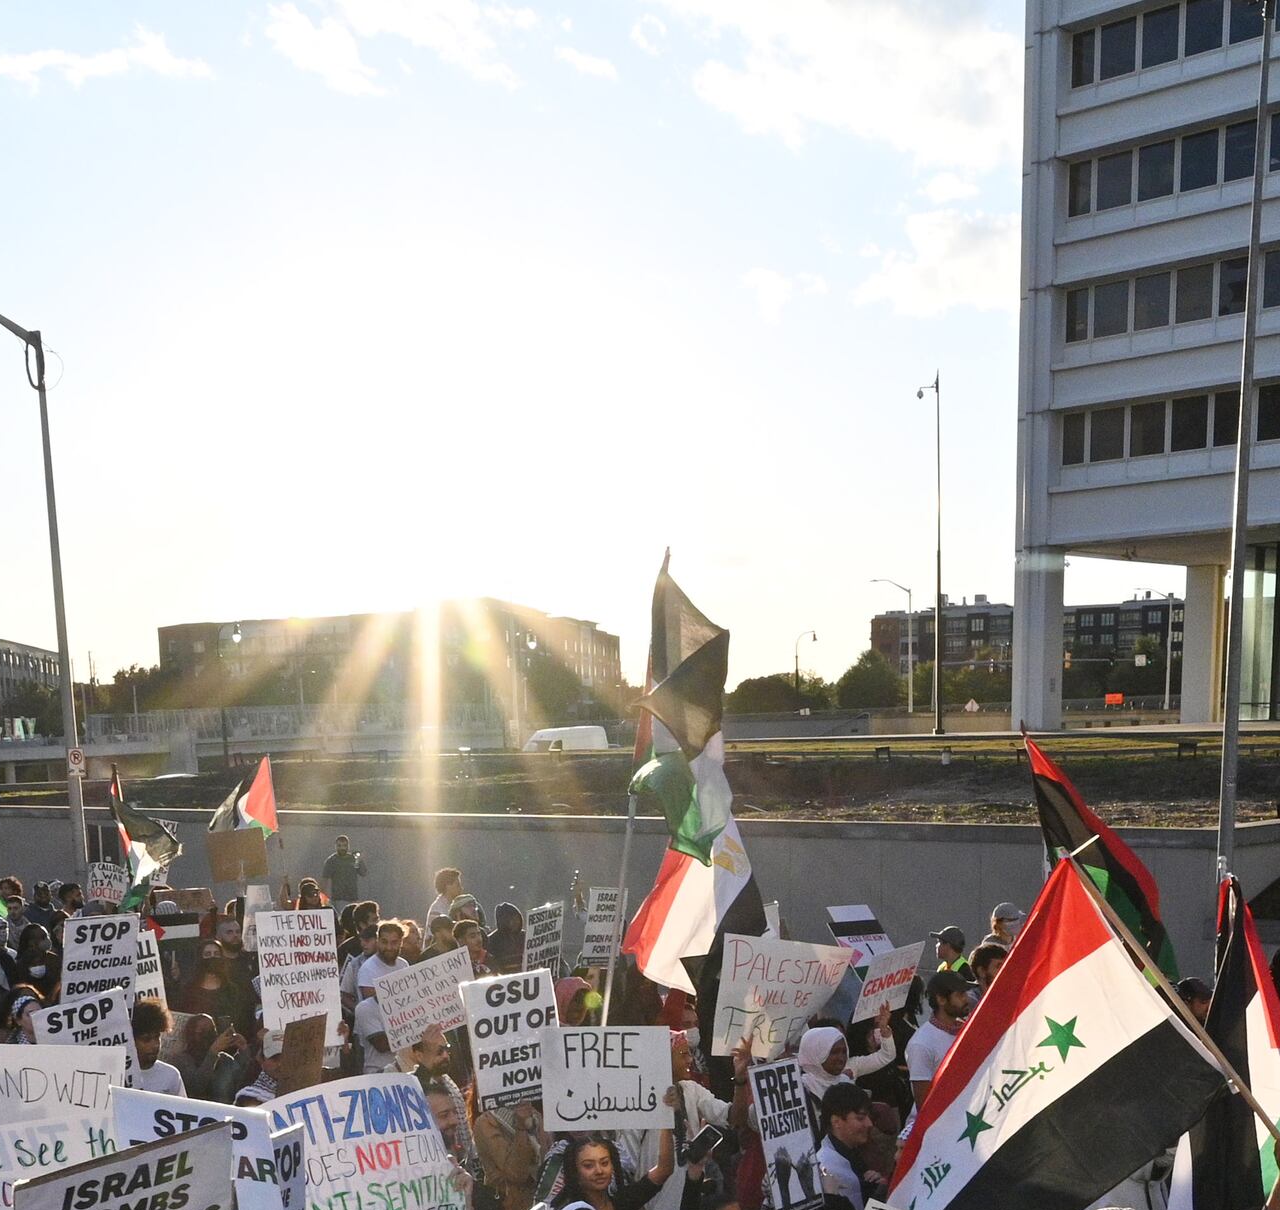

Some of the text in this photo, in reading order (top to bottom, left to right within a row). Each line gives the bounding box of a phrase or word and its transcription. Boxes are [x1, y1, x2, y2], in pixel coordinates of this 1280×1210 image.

[271, 914, 327, 931] THE DEVIL
[259, 933, 333, 949] WORKS HARD BUT
[260, 951, 337, 969] ISRAELI PROPAGANDA
[729, 939, 847, 985] PALESTINE
[485, 977, 540, 1008] GSU
[862, 965, 916, 998] GENOCIDE
[277, 989, 326, 1010] SPREADING
[752, 989, 813, 1008] WILL BE
[474, 1005, 557, 1039] OUT OF
[722, 1005, 808, 1046] FREE
[563, 1031, 641, 1069] FREE
[502, 1067, 542, 1088] NOW
[754, 1062, 803, 1114] FREE
[556, 1074, 658, 1122] فلسطين
[760, 1107, 808, 1143] PALESTINE
[355, 1139, 402, 1176] NOT
